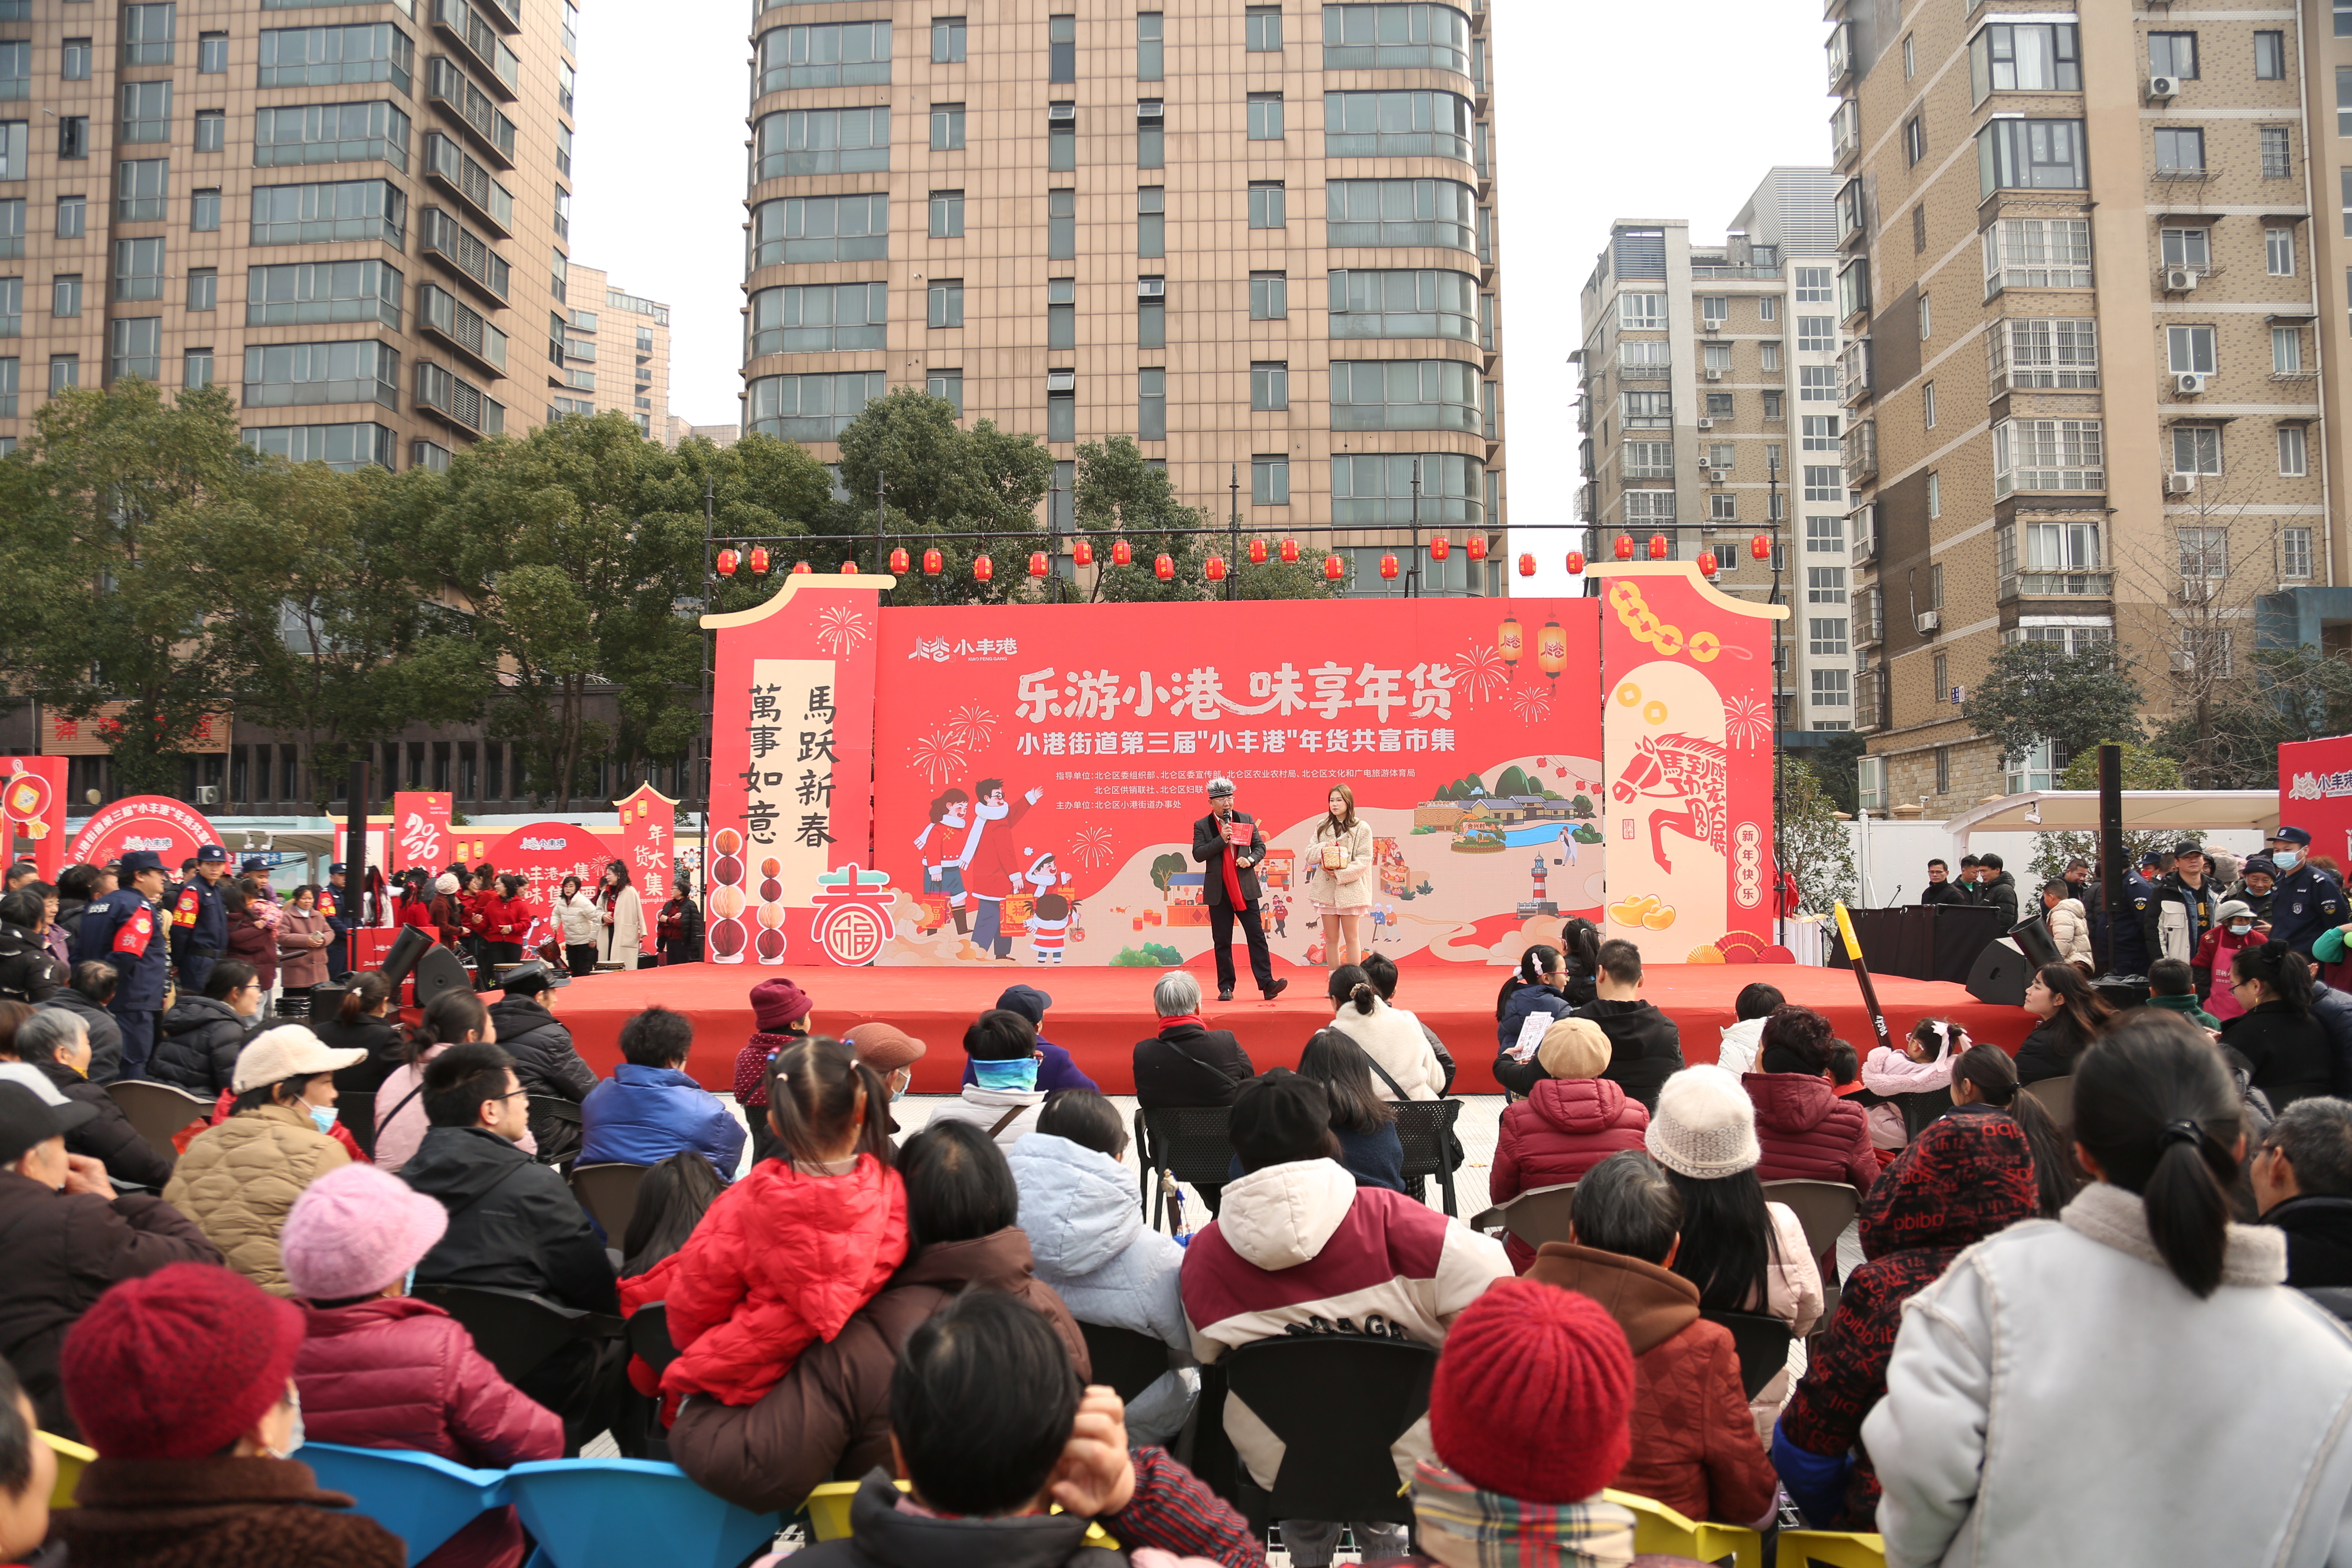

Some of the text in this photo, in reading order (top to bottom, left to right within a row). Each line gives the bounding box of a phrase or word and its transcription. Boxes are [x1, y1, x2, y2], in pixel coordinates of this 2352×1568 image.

[953, 637, 1018, 656] 小丰港
[1015, 661, 1456, 724] 乐游小港 味享年货
[739, 683, 783, 844] 萬事如意
[633, 824, 668, 896] 年货大集
[1742, 830, 1754, 900] 新年快乐
[173, 910, 197, 925] 执勤
[1012, 905, 1026, 917] 福
